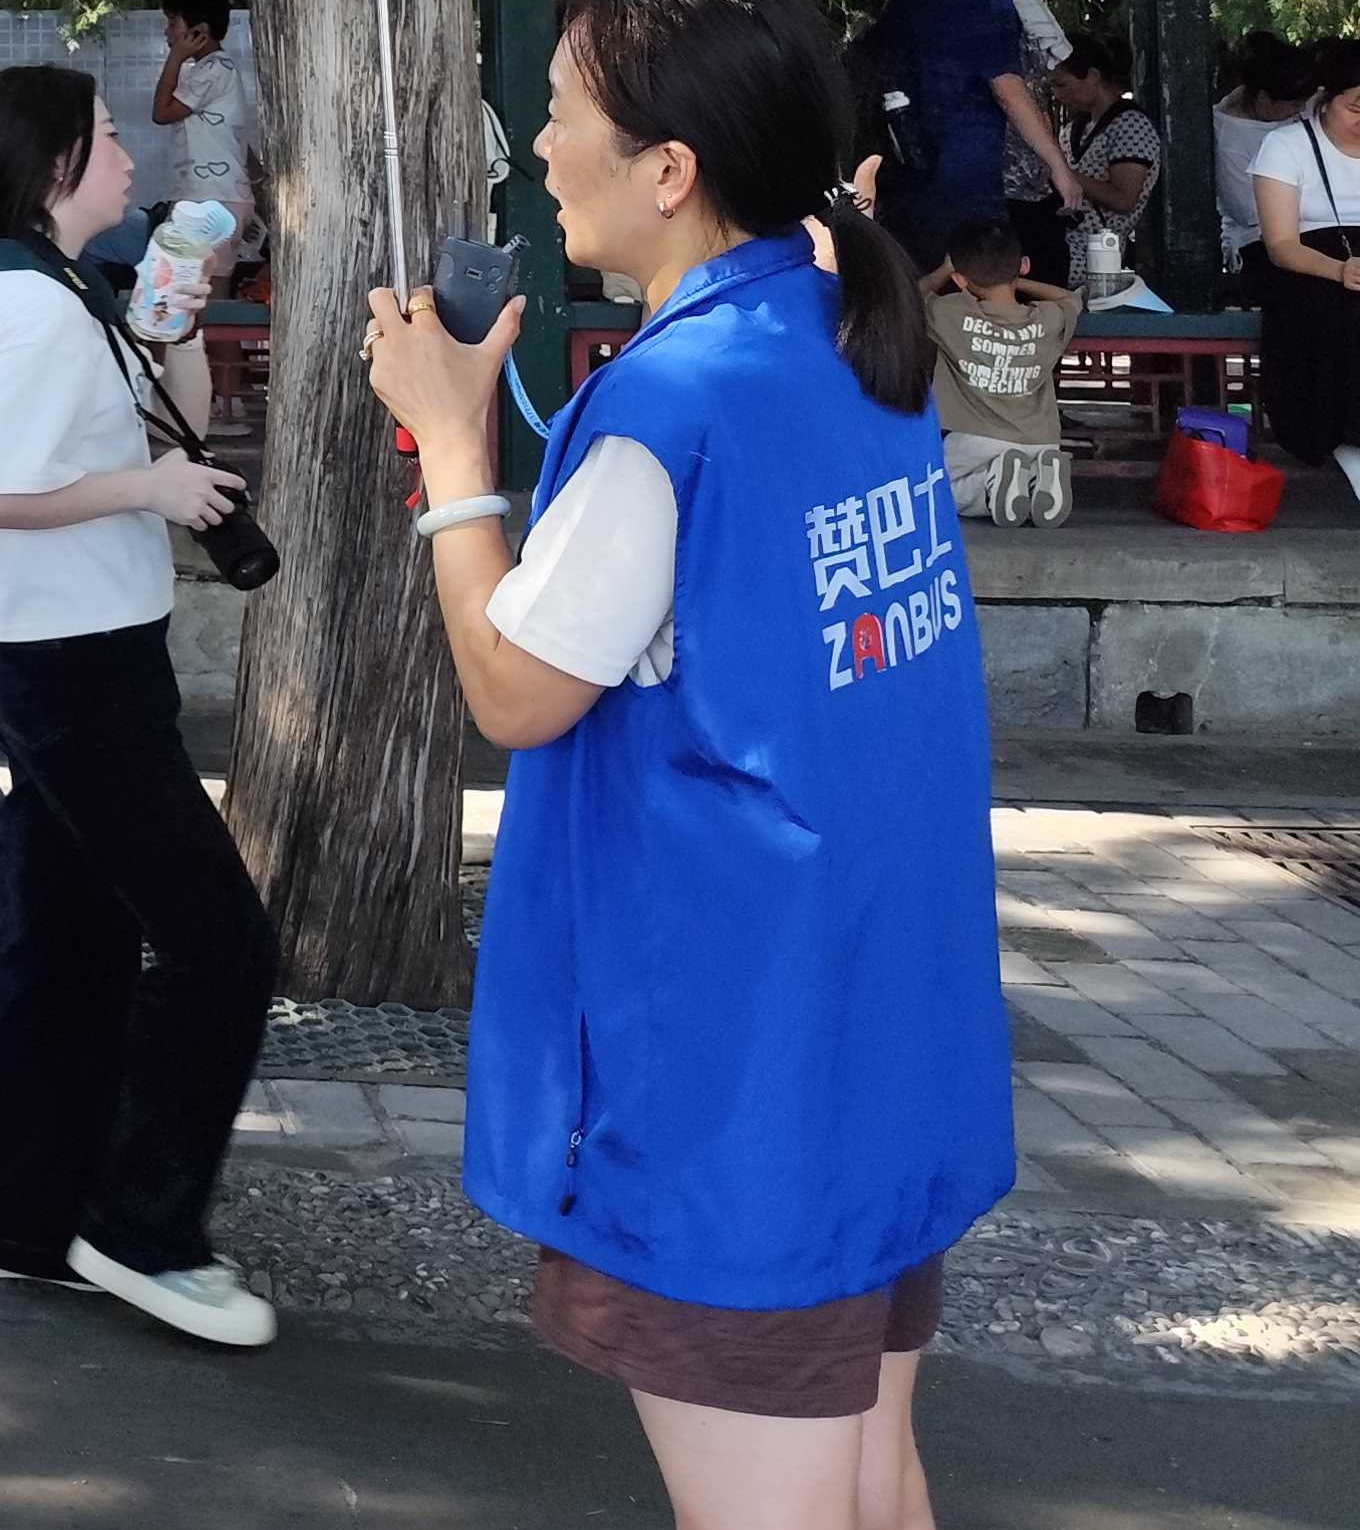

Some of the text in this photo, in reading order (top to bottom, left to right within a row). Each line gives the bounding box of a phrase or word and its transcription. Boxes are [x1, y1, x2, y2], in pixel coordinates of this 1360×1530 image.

[805, 462, 952, 612] 赞巴士
[822, 569, 962, 691] ZANBUS
